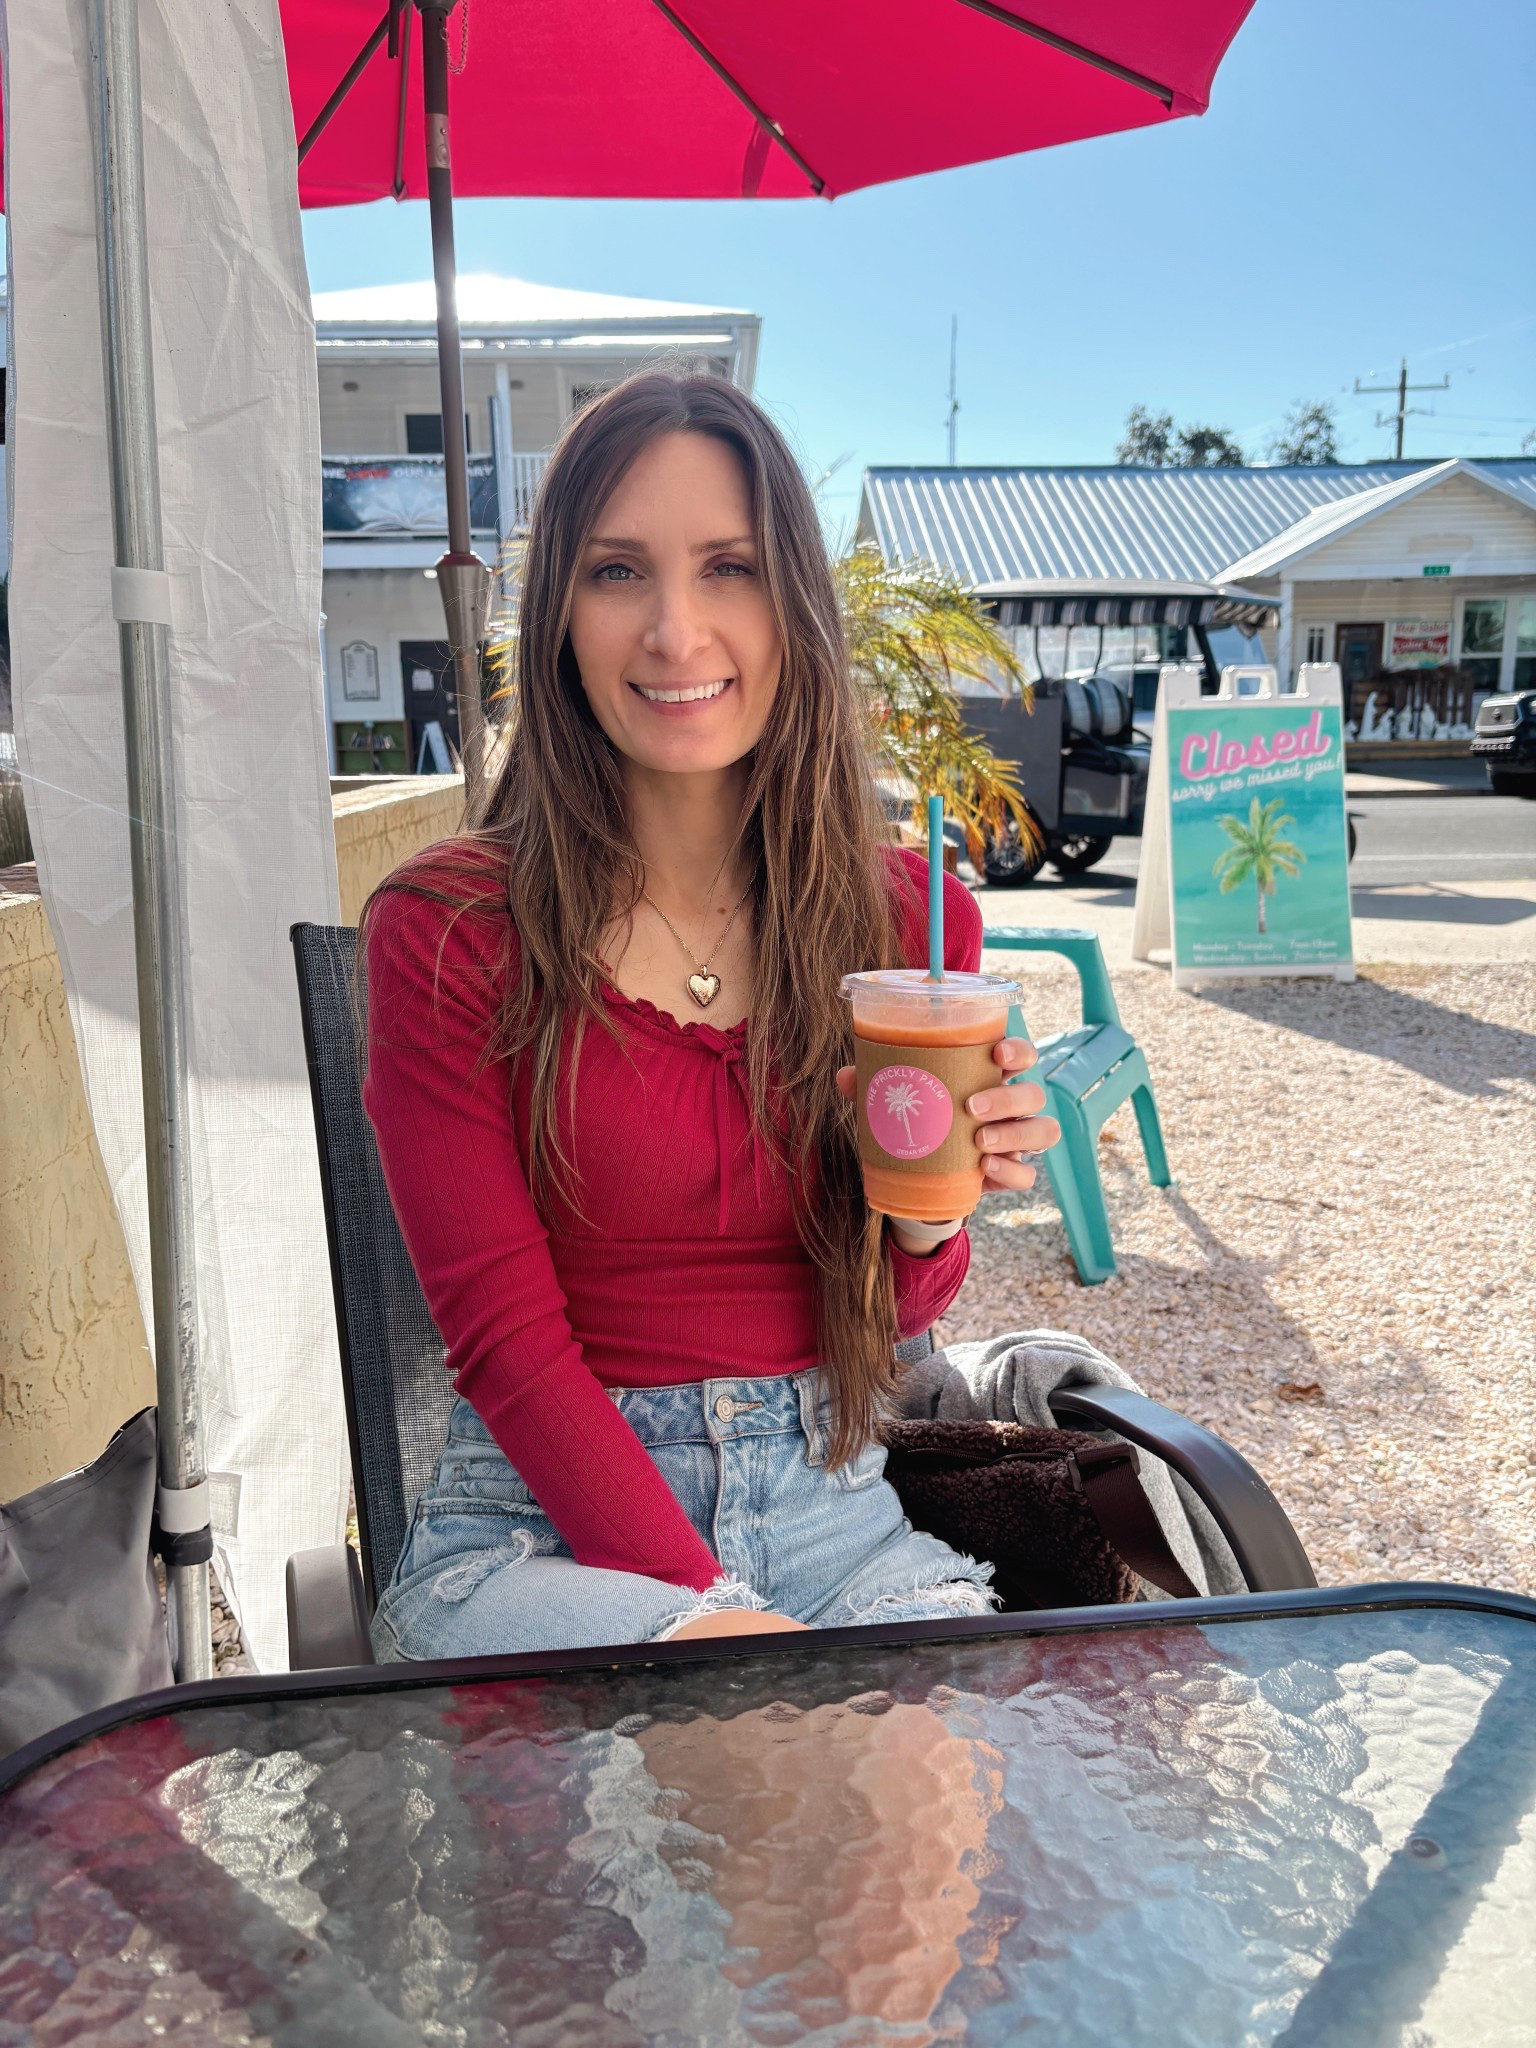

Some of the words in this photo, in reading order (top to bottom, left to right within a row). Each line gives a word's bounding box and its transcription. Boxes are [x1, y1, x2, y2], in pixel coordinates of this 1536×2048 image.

[1179, 710, 1332, 781] Closed
[1171, 783, 1216, 802] sorry
[1220, 776, 1244, 793] we
[1247, 762, 1302, 787] missed
[1305, 752, 1343, 782] you!
[868, 1086, 877, 1106] THE
[874, 1068, 916, 1087] PRICKLY
[919, 1073, 946, 1100] PALM
[896, 1147, 918, 1156] CEDAR
[918, 1144, 930, 1154] KEY
